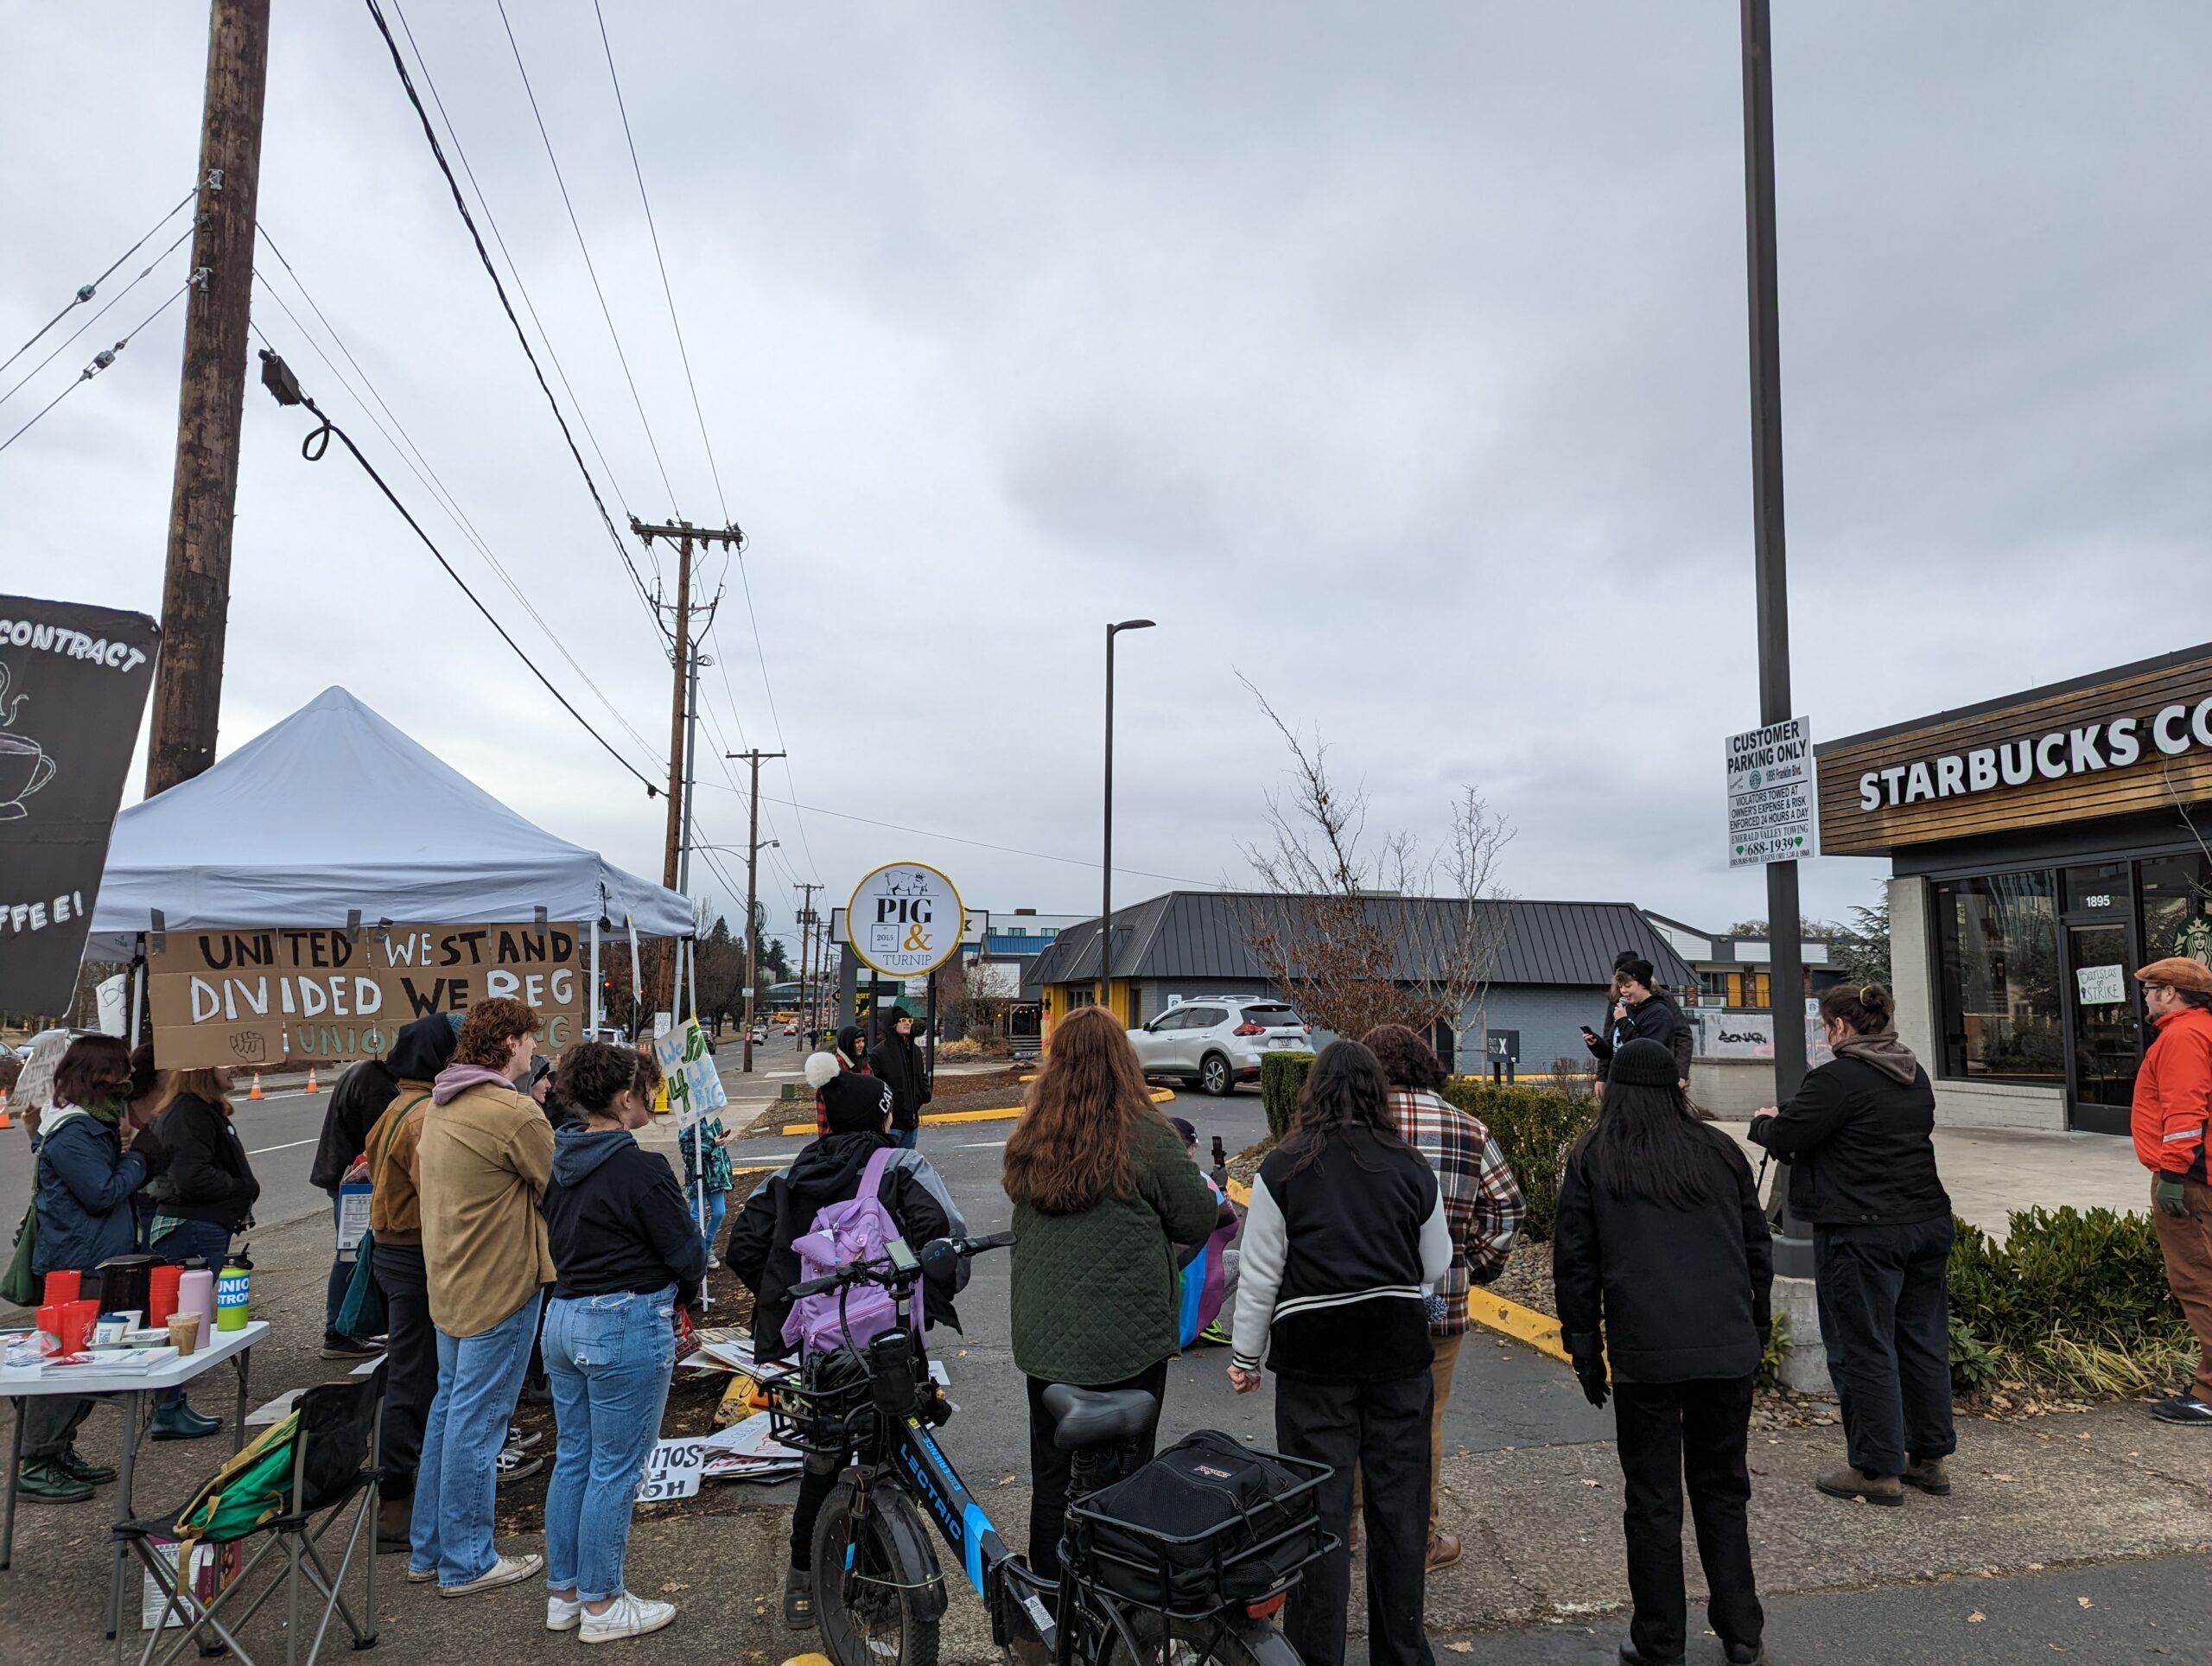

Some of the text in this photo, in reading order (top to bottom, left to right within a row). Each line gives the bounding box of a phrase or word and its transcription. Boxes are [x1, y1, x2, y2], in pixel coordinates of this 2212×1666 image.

[0, 620, 146, 672] CONTRACT
[1733, 721, 1800, 754] CUSTOMER
[1728, 739, 1807, 774] PARKING ONLY
[1859, 718, 2143, 811] STARBUCKS
[1776, 766, 1791, 779] Franklin
[1731, 796, 1807, 819] OWNER'S EXPENSE & RISK
[1735, 785, 1799, 807] VIOLATORS TOWED AT
[1730, 807, 1809, 830] ENFORCED 24 HOURS A DAY
[1731, 823, 1808, 844] EMERALD VALLEY TOWING
[1747, 836, 1794, 856] 688-1939
[875, 898, 933, 924] PIG
[2086, 894, 2111, 907] 1895
[198, 928, 573, 970] UNITED WE STAND
[903, 923, 933, 951] &
[882, 954, 932, 966] TURNIP
[2078, 968, 2117, 984] Baristas
[189, 975, 383, 1025] DIVIDED
[400, 977, 470, 1019] WE
[2087, 984, 2120, 1002] STRIKE
[658, 1040, 684, 1065] We
[668, 1068, 690, 1114] 4
[900, 1443, 962, 1541] LECTRIC
